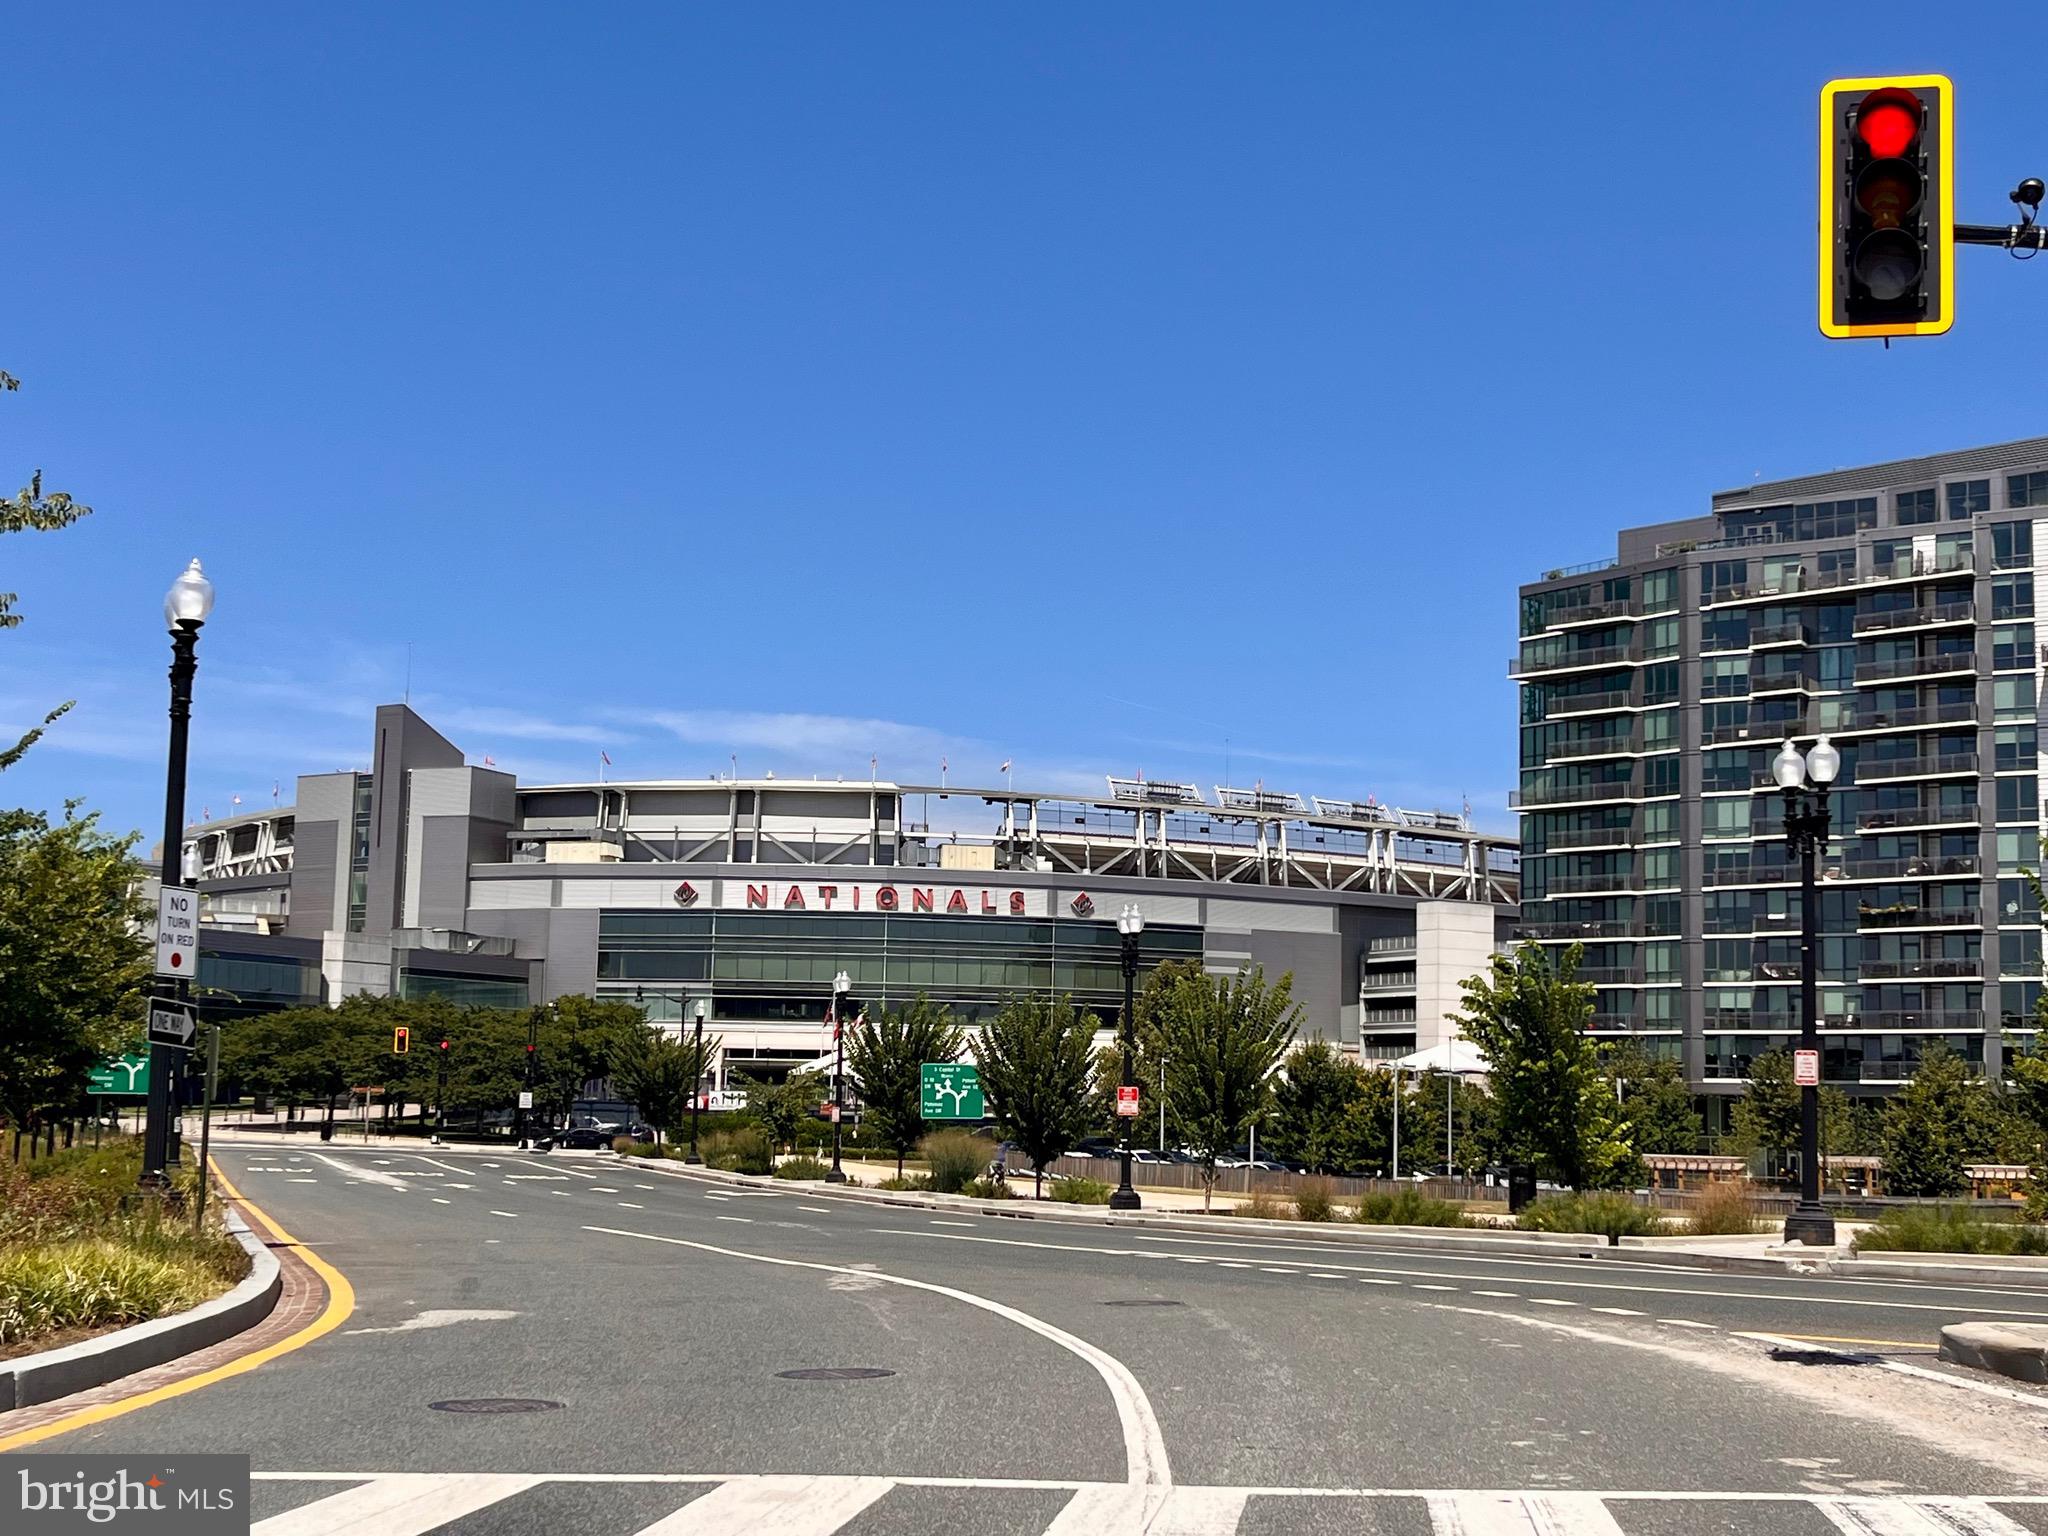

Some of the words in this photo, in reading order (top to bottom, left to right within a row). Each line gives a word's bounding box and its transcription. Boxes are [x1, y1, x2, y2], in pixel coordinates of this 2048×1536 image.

[170, 897, 189, 911] NO
[747, 884, 1026, 915] NATIONALS
[167, 915, 191, 929] TURN
[160, 932, 174, 945] ON
[176, 934, 195, 947] RED
[154, 1012, 169, 1031] ONE
[170, 1014, 184, 1034] WAY
